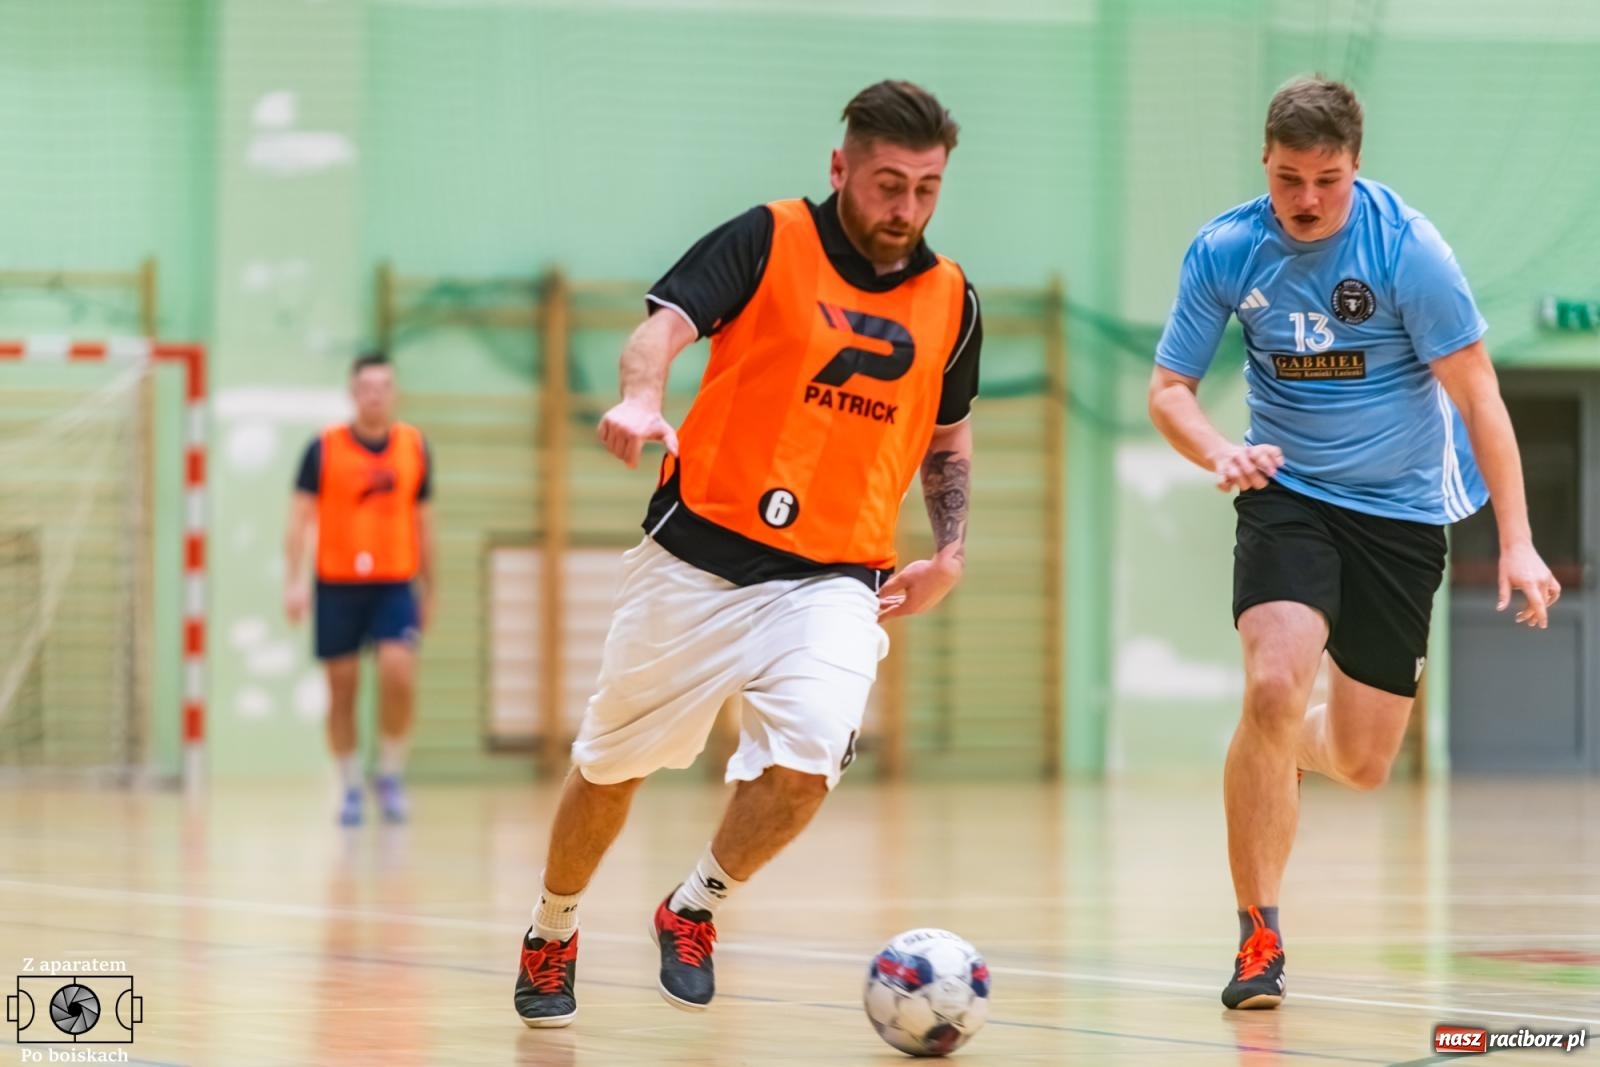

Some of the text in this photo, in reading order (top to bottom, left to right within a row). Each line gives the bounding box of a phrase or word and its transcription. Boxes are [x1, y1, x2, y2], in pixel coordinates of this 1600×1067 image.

[1289, 312, 1335, 352] 13
[1275, 355, 1364, 368] GABRIEL
[804, 385, 898, 425] PATRICK
[765, 490, 794, 526] 6
